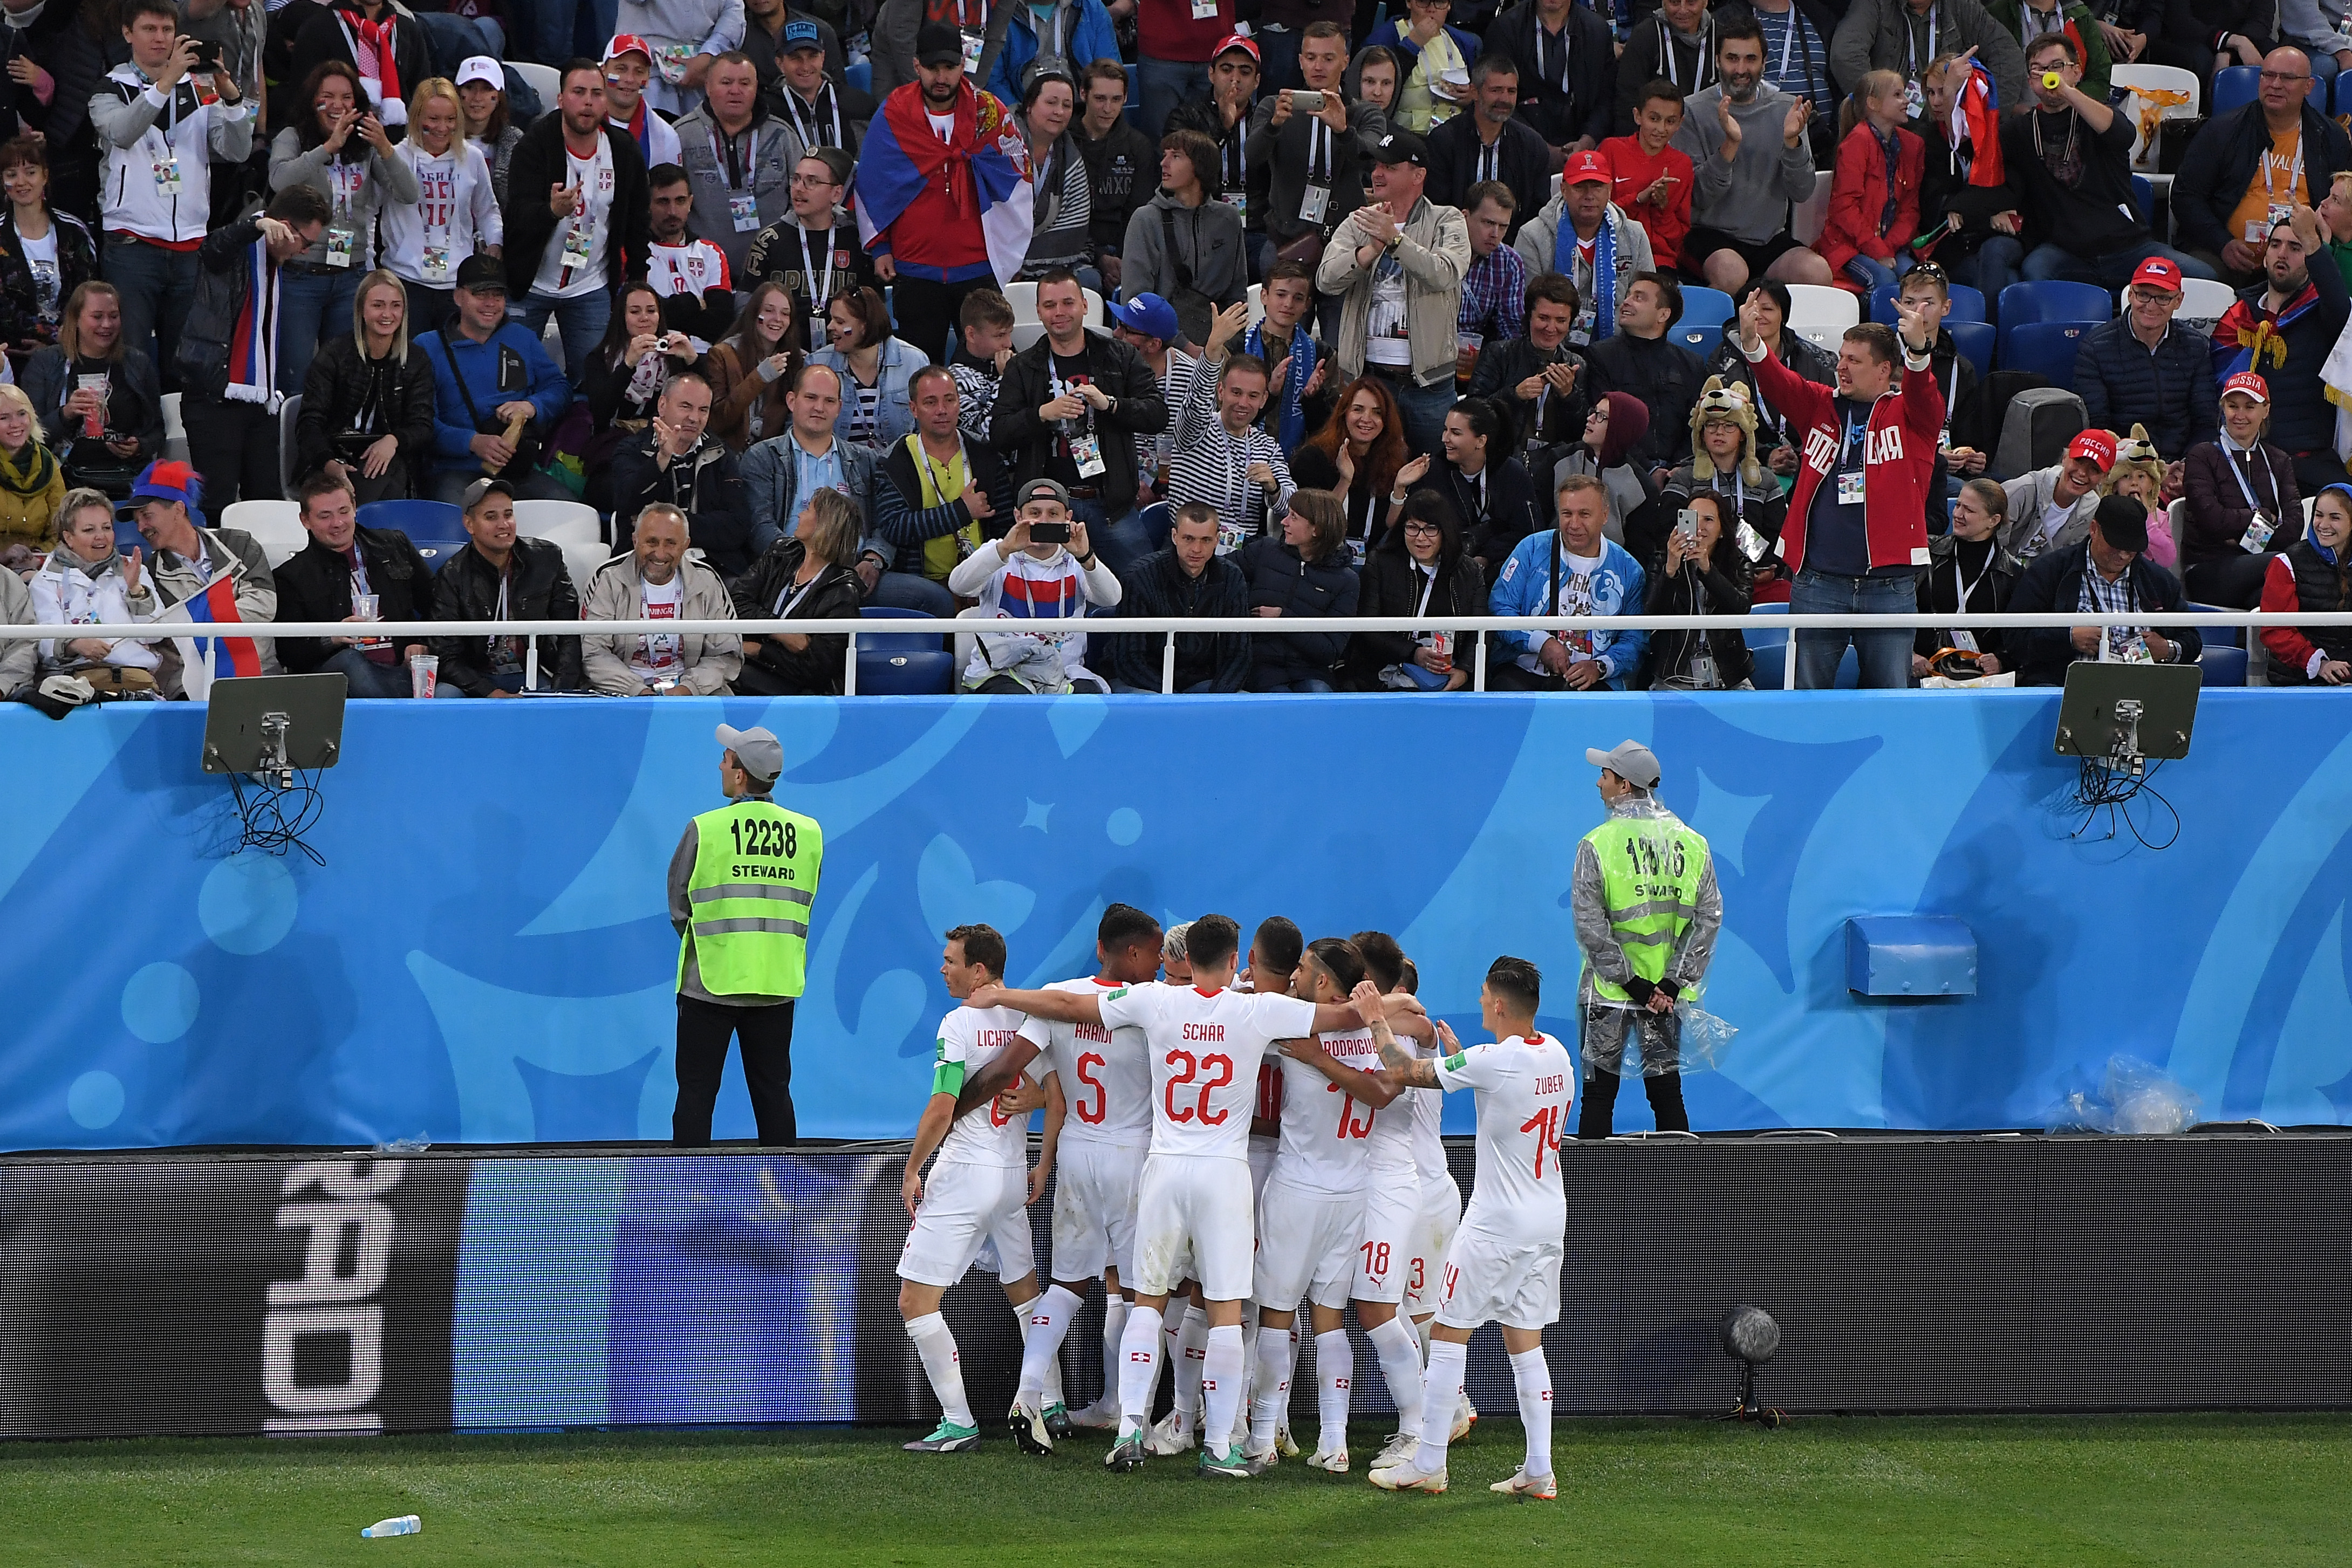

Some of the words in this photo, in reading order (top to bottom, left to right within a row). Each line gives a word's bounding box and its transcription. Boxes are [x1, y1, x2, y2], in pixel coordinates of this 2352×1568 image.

[1291, 366, 1303, 416] RUSSIA
[2227, 373, 2262, 391] RUSSIA
[2079, 437, 2110, 457] РОССИЯ
[730, 818, 797, 859] 12238
[731, 865, 795, 880] STEWARD
[1635, 885, 1682, 899] STWARD
[977, 1029, 1018, 1047] LICHTST
[1182, 1022, 1225, 1042] SCHÄR
[1324, 1037, 1377, 1057] RODRIGUE
[1076, 1051, 1106, 1125] 5
[1165, 1049, 1234, 1126] 22
[1534, 1073, 1564, 1096] ZUBER
[1519, 1099, 1572, 1180] 14
[1359, 1241, 1391, 1275] 18
